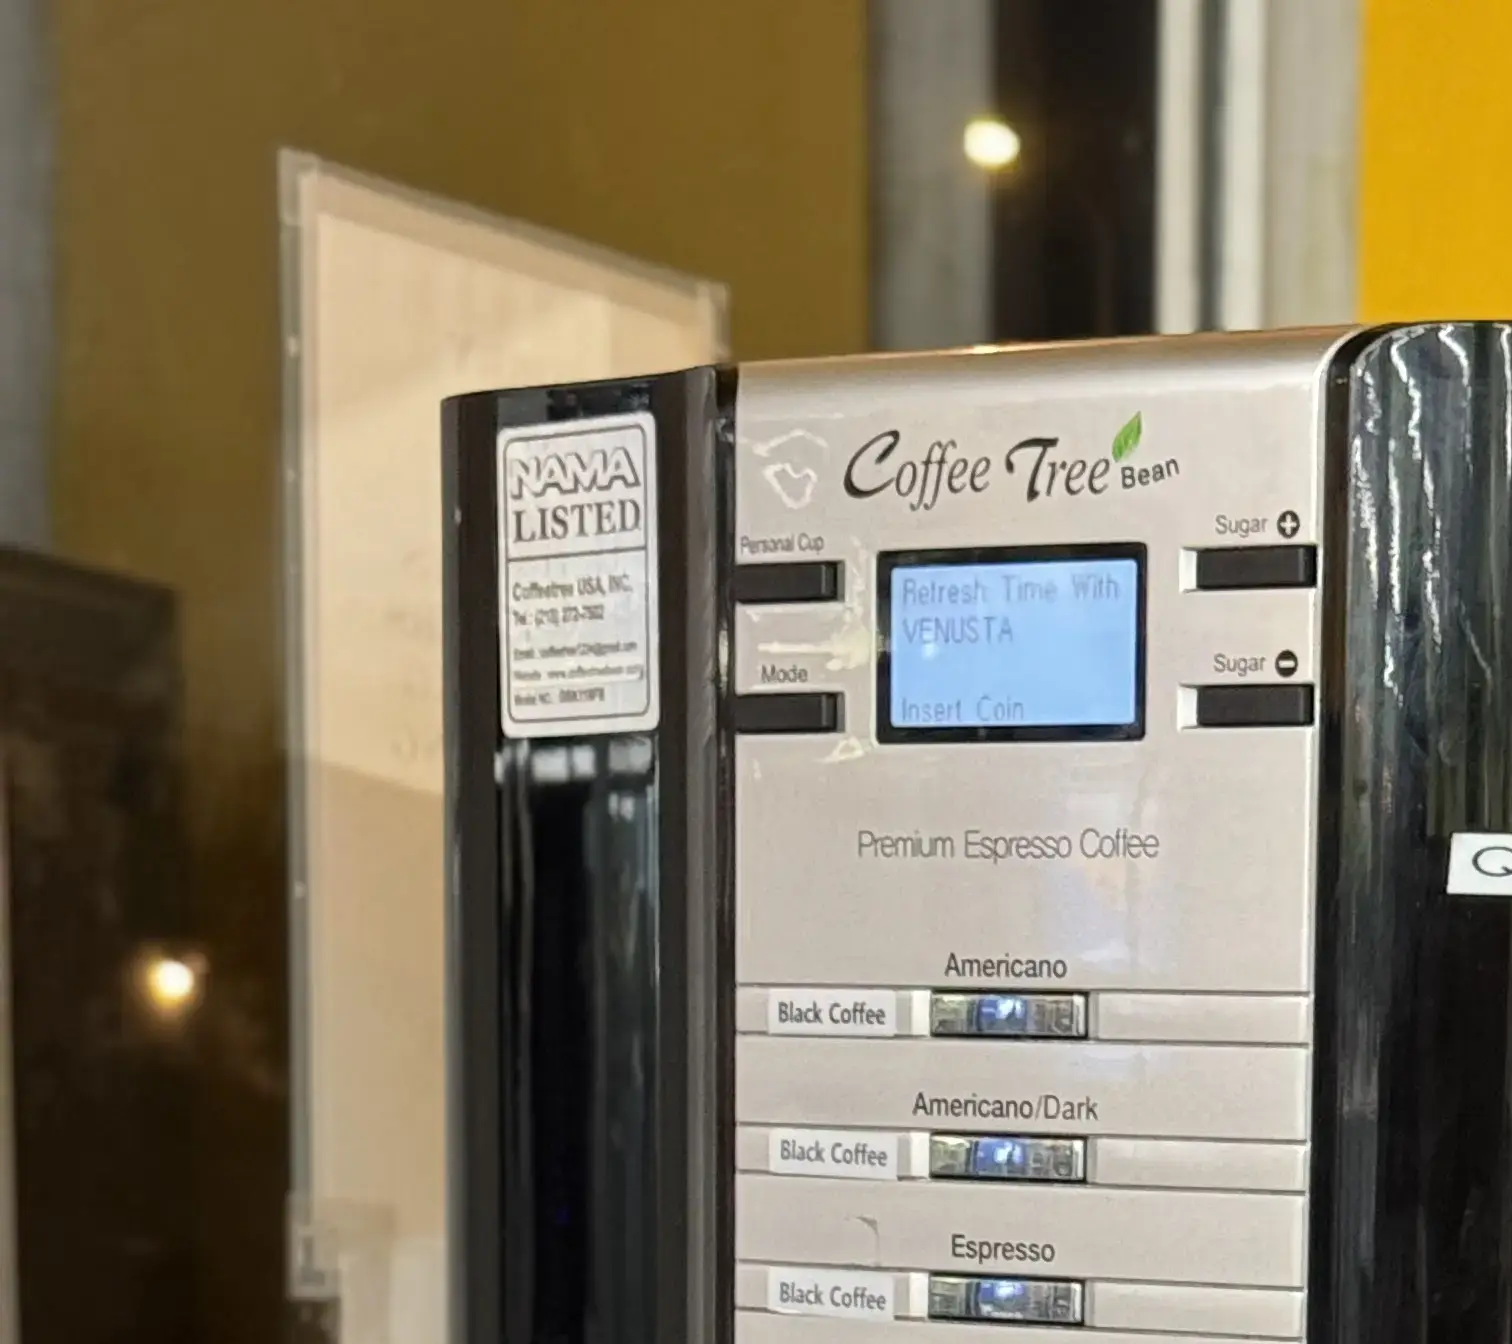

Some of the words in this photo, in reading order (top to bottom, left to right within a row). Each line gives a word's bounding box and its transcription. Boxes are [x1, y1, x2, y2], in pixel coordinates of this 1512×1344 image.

[510, 447, 641, 500] NAMA
[844, 429, 990, 511] Coffee
[1005, 437, 1112, 503] Tree
[1120, 457, 1180, 490] Bean
[512, 499, 642, 544] LISTED
[1215, 514, 1269, 538] Sugar
[740, 533, 795, 556] Personal
[798, 532, 826, 556] Cup
[902, 578, 987, 606] Refresh
[1002, 575, 1059, 605] Time
[1072, 573, 1120, 601] With
[902, 615, 1015, 644] VENUSTA
[760, 664, 809, 684] Mode
[1213, 653, 1267, 677] Sugar
[902, 697, 962, 723] Insert
[977, 696, 1025, 722] Coin
[857, 831, 955, 859] Premium
[965, 830, 1073, 863] Espresso
[1079, 828, 1161, 860] Coffee
[944, 952, 1069, 980] Americano
[777, 1002, 823, 1025] Black
[828, 1003, 887, 1027] Coffee
[912, 1092, 1100, 1122] Americano/Dark
[779, 1139, 826, 1163] Black
[830, 1142, 889, 1167] Coffee
[951, 1234, 1057, 1264] Espresso
[778, 1281, 825, 1305] Black
[828, 1286, 888, 1311] Coffee
